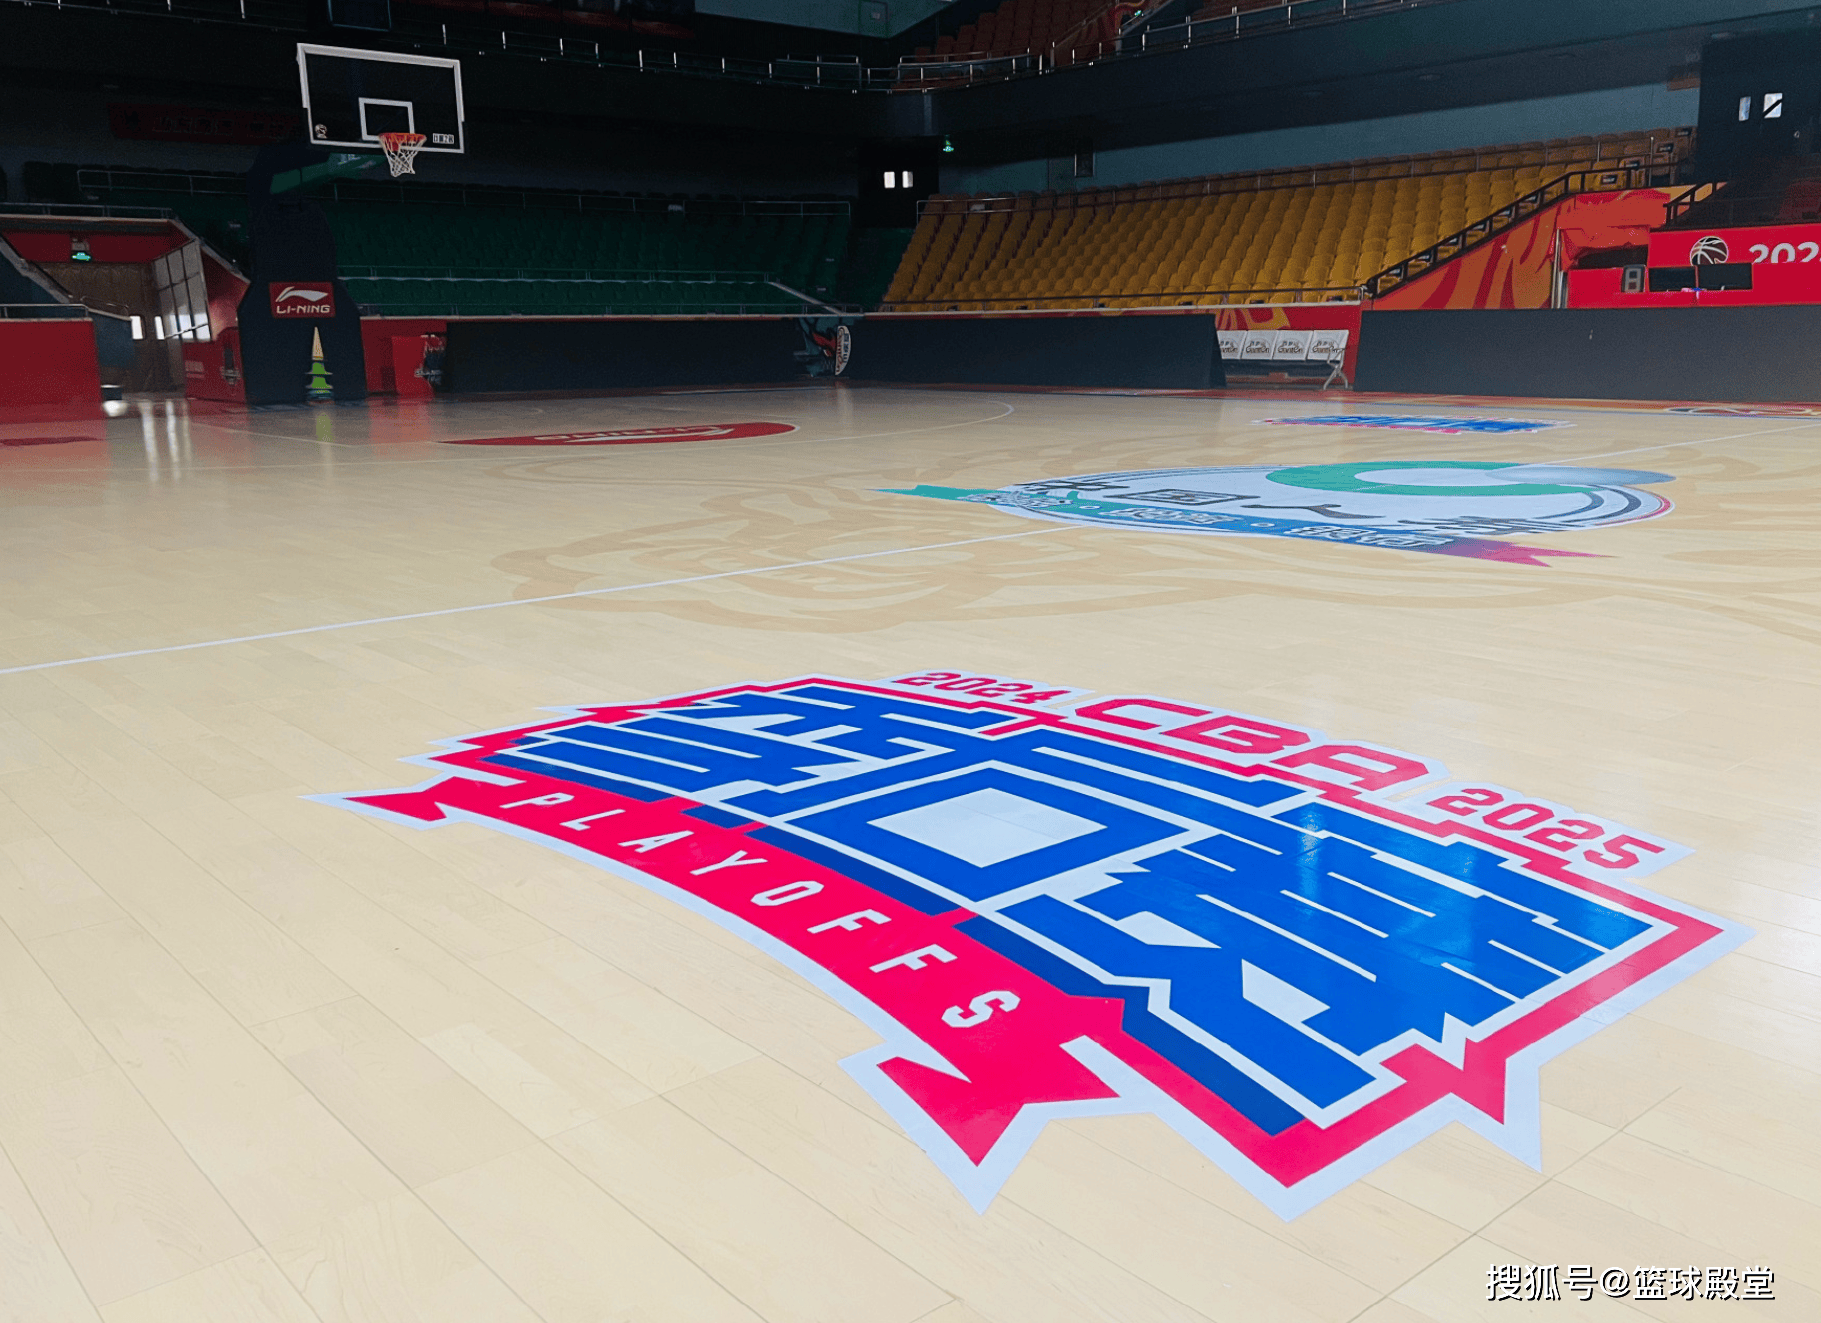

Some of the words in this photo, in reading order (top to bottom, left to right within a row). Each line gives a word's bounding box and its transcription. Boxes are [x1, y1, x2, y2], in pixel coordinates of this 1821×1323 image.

[276, 304, 331, 314] LI-NING
[1748, 241, 1821, 265] 202
[894, 671, 1070, 704] 2024
[1075, 698, 1429, 792] CBA
[1426, 788, 1666, 869] 2025
[484, 685, 1655, 1136] 季后赛
[500, 791, 1022, 1029] PLAYOFFS
